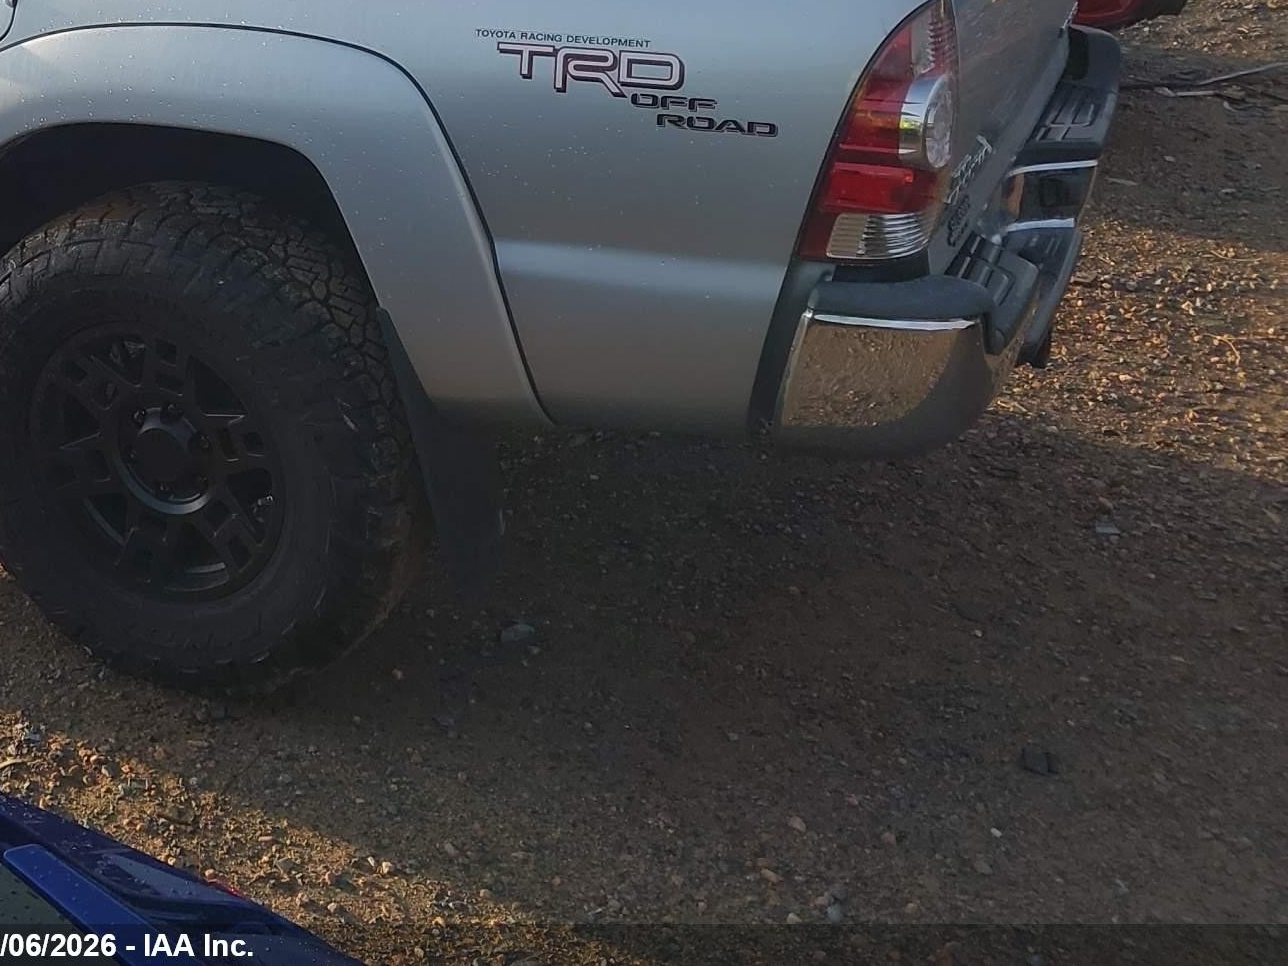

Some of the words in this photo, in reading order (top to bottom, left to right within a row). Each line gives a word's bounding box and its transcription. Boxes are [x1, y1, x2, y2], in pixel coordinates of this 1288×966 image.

[475, 28, 517, 40] TOYOTA
[520, 31, 562, 43] RACING
[566, 35, 652, 48] DEVELOPMENT
[497, 41, 685, 98] TRD
[630, 92, 718, 112] OFF
[656, 113, 779, 137] ROAD
